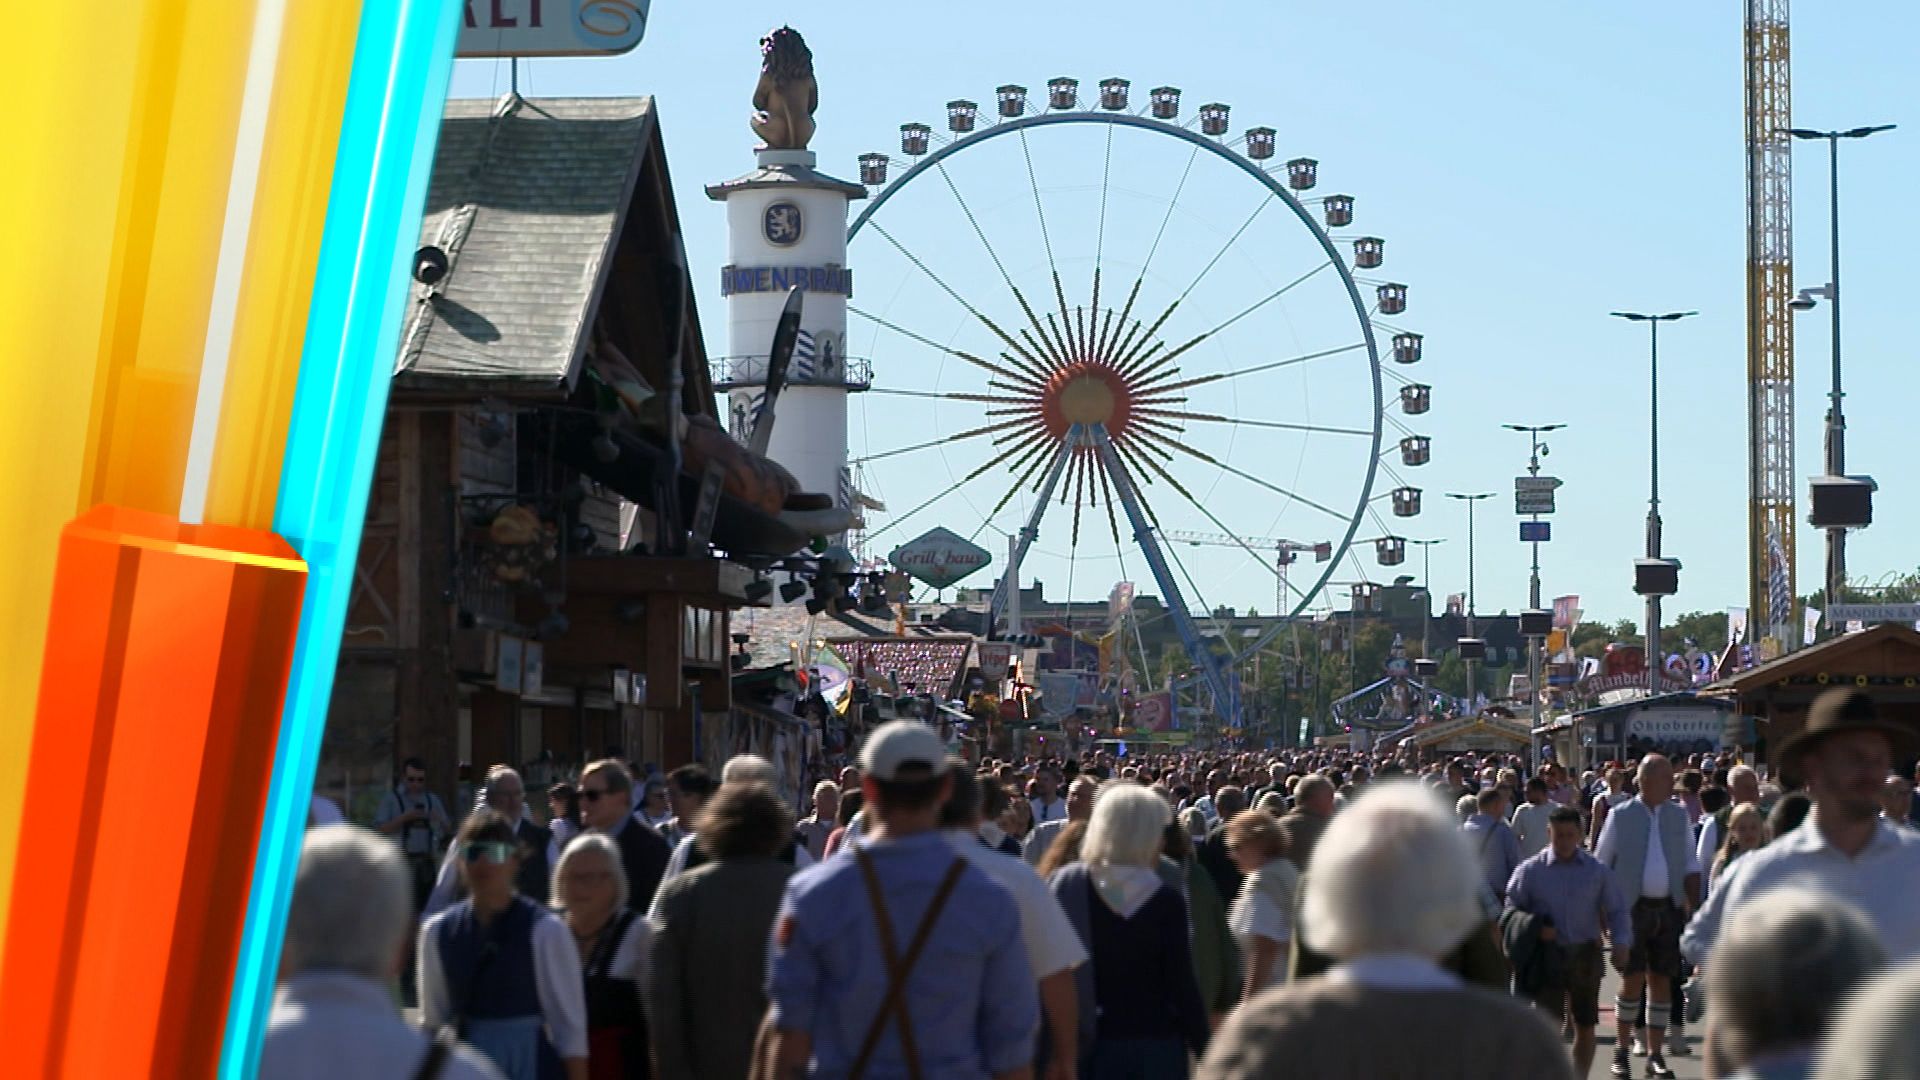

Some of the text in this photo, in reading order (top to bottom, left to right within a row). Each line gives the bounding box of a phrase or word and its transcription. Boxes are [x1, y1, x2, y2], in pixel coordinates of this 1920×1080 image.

[899, 550, 937, 564] Grill
[1832, 606, 1895, 618] MANDELN
[1632, 719, 1721, 732] Oktoberfes
